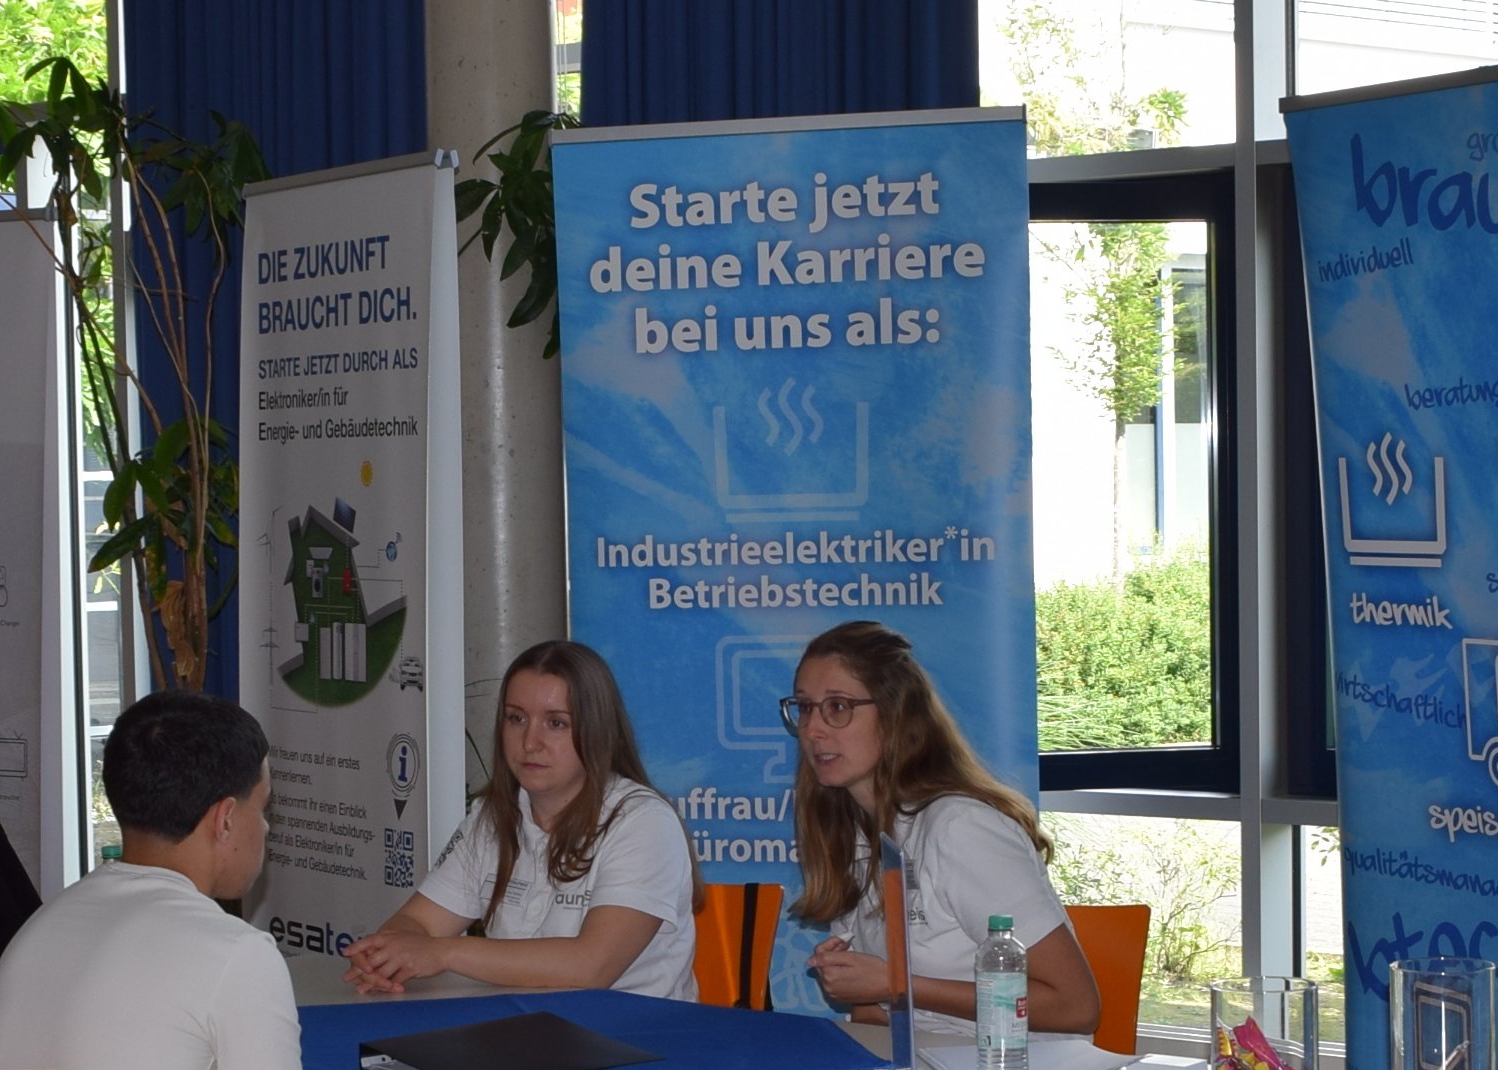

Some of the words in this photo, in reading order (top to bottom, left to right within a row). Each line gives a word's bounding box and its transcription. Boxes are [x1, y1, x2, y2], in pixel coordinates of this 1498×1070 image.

[629, 181, 798, 229] Starte
[809, 171, 939, 233] jetzt
[258, 249, 288, 284] DIE
[293, 235, 390, 280] ZUKUNFT
[589, 243, 742, 293] deine
[756, 233, 986, 287] Karriere
[1317, 237, 1414, 283] individuell
[258, 292, 353, 334] BRAUCHT
[359, 286, 417, 324] DICH.
[635, 305, 717, 354] bei
[734, 313, 832, 351] uns
[845, 297, 939, 348] als:
[258, 357, 300, 379] STARTE
[303, 354, 340, 376] JETZT
[343, 350, 388, 373] DURCH
[392, 347, 418, 369] ALS
[258, 387, 330, 411] Elektroniker/in
[333, 386, 349, 407] für
[258, 422, 300, 445] Energie-
[303, 419, 322, 440] und
[325, 415, 418, 439] Gebäudetechnik
[649, 572, 944, 609] Betriebstechnik
[1349, 592, 1453, 630] thermik
[269, 916, 357, 958] esate
